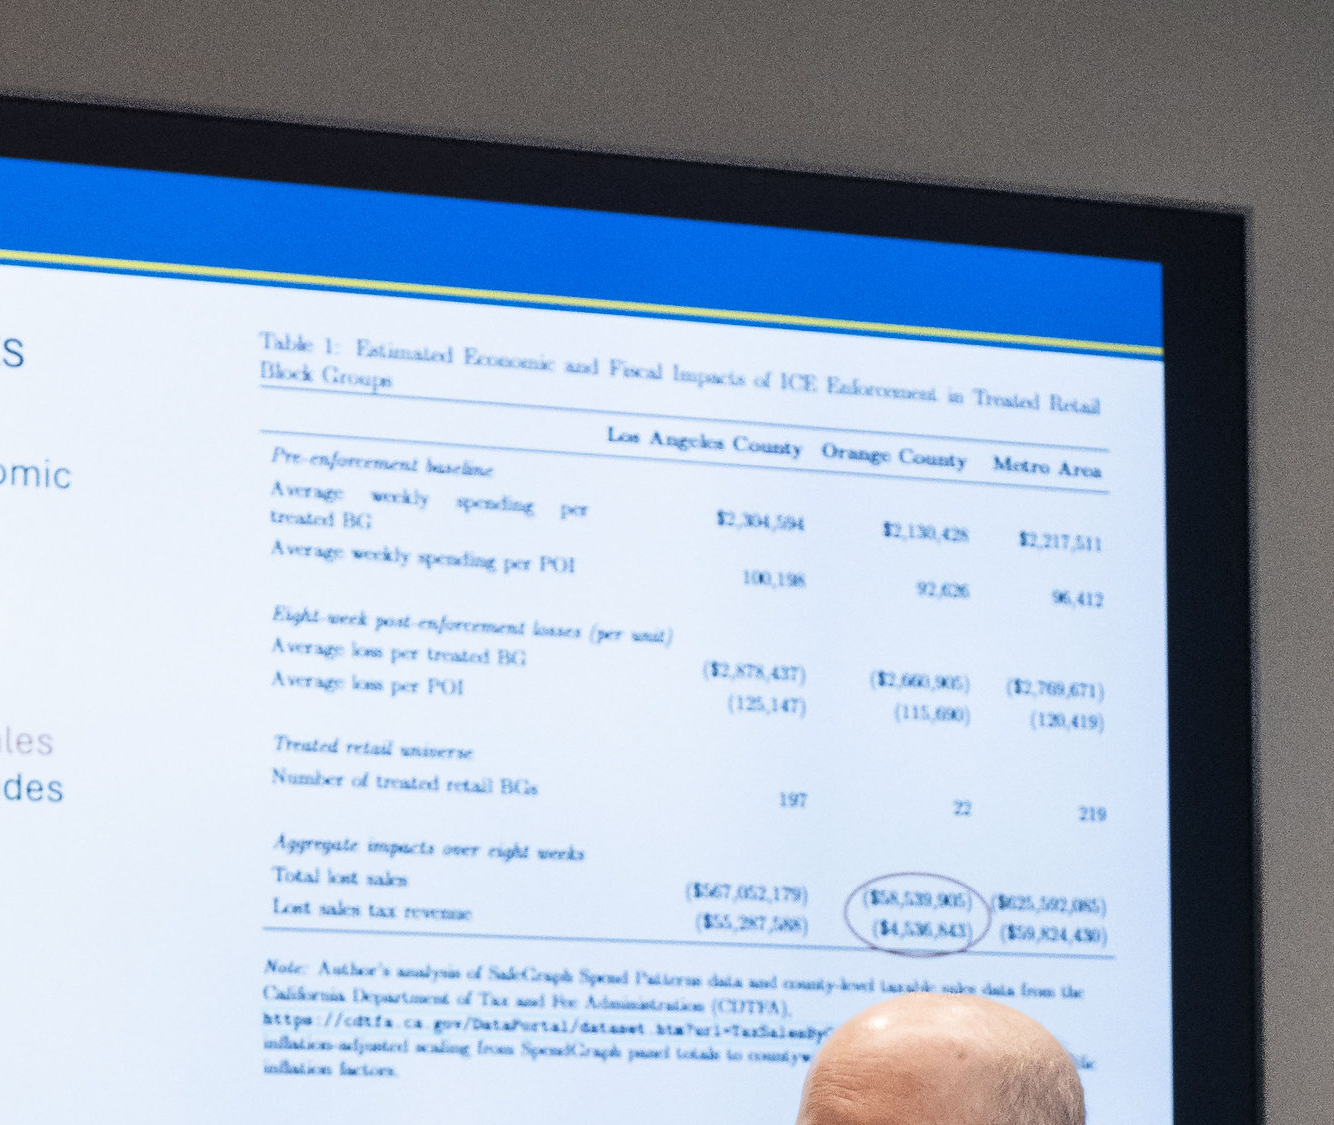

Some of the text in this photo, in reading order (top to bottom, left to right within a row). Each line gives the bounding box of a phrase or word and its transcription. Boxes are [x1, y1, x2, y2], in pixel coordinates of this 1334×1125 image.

[260, 331, 1101, 416] Table 1: Estimated Economic and Fiscal Impacts of ICE Enforcement in Treated Retail
[260, 360, 394, 394] Block Groups
[607, 425, 804, 460] Los Angeles County
[821, 441, 967, 472] Orange County
[270, 447, 494, 478] Pre-enforcement baseline
[993, 454, 1102, 479] Metro Area
[270, 480, 588, 521] Average weekly spending per
[269, 510, 373, 531] treated BG
[271, 539, 531, 575] Average weekly spending per
[271, 605, 581, 641] Eight-week post-enforcement losses
[271, 637, 527, 668] Average loss per treated BG
[271, 670, 419, 698] Average loss per
[273, 734, 474, 761] Treated retail universe
[271, 767, 539, 797] Number of treated retail BGs
[779, 790, 808, 810] 197
[953, 799, 973, 818] 22
[1079, 805, 1108, 823] 219
[273, 833, 586, 863] Aggregate impacts over eight weeks
[272, 865, 408, 888] Total lost sales
[273, 897, 473, 922] Lost sales tax revenue
[397, 964, 461, 983] analysis
[578, 968, 629, 989] Spend
[635, 970, 702, 988] Patterns
[262, 985, 705, 1014] California Department Administration
